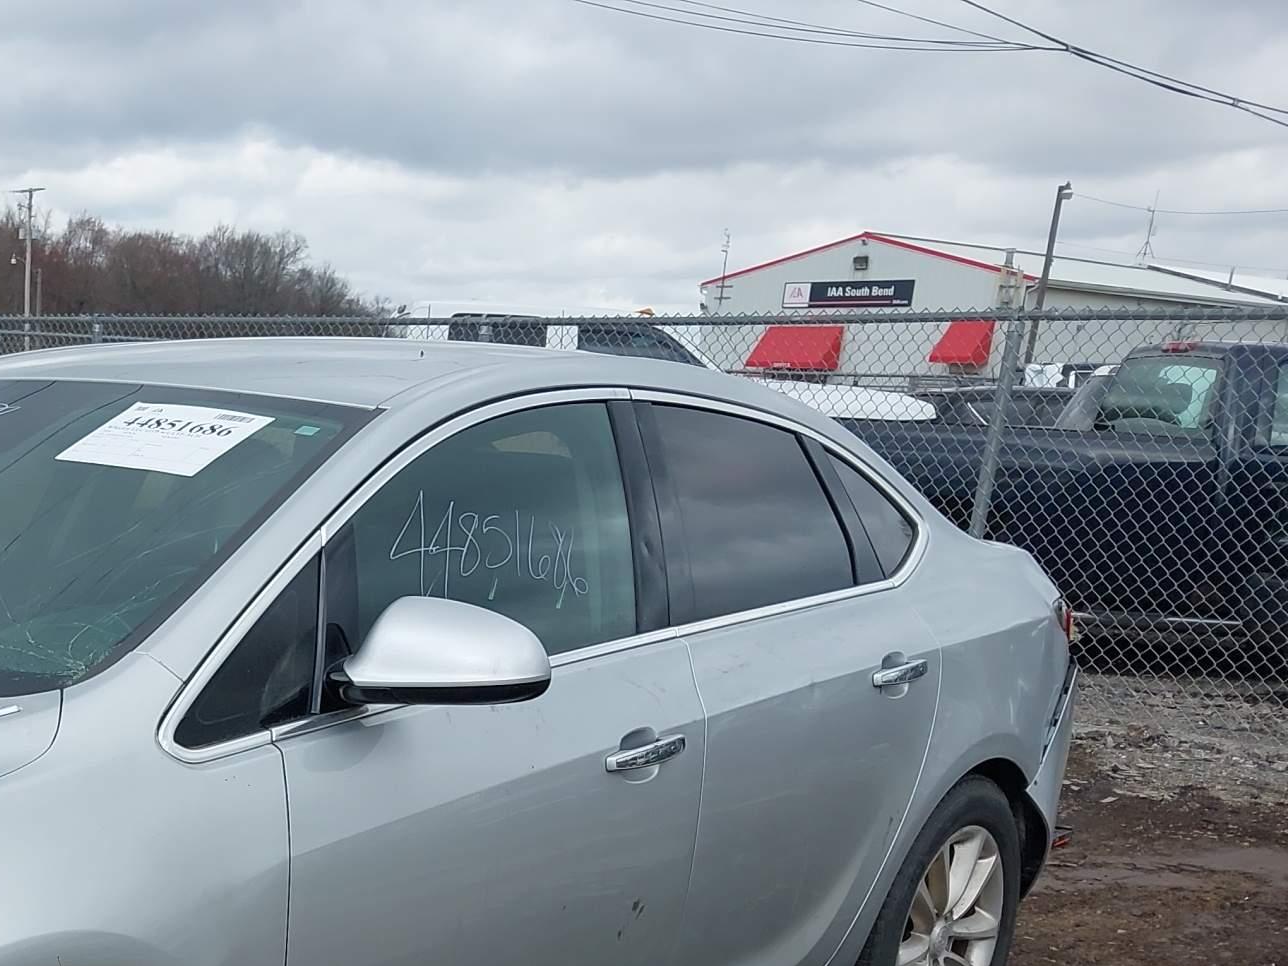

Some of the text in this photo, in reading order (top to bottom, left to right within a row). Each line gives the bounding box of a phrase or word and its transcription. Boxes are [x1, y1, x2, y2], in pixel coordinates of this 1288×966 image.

[827, 285, 894, 297] IAA South Bend
[124, 416, 240, 437] 44851686
[389, 489, 589, 598] 44851686
